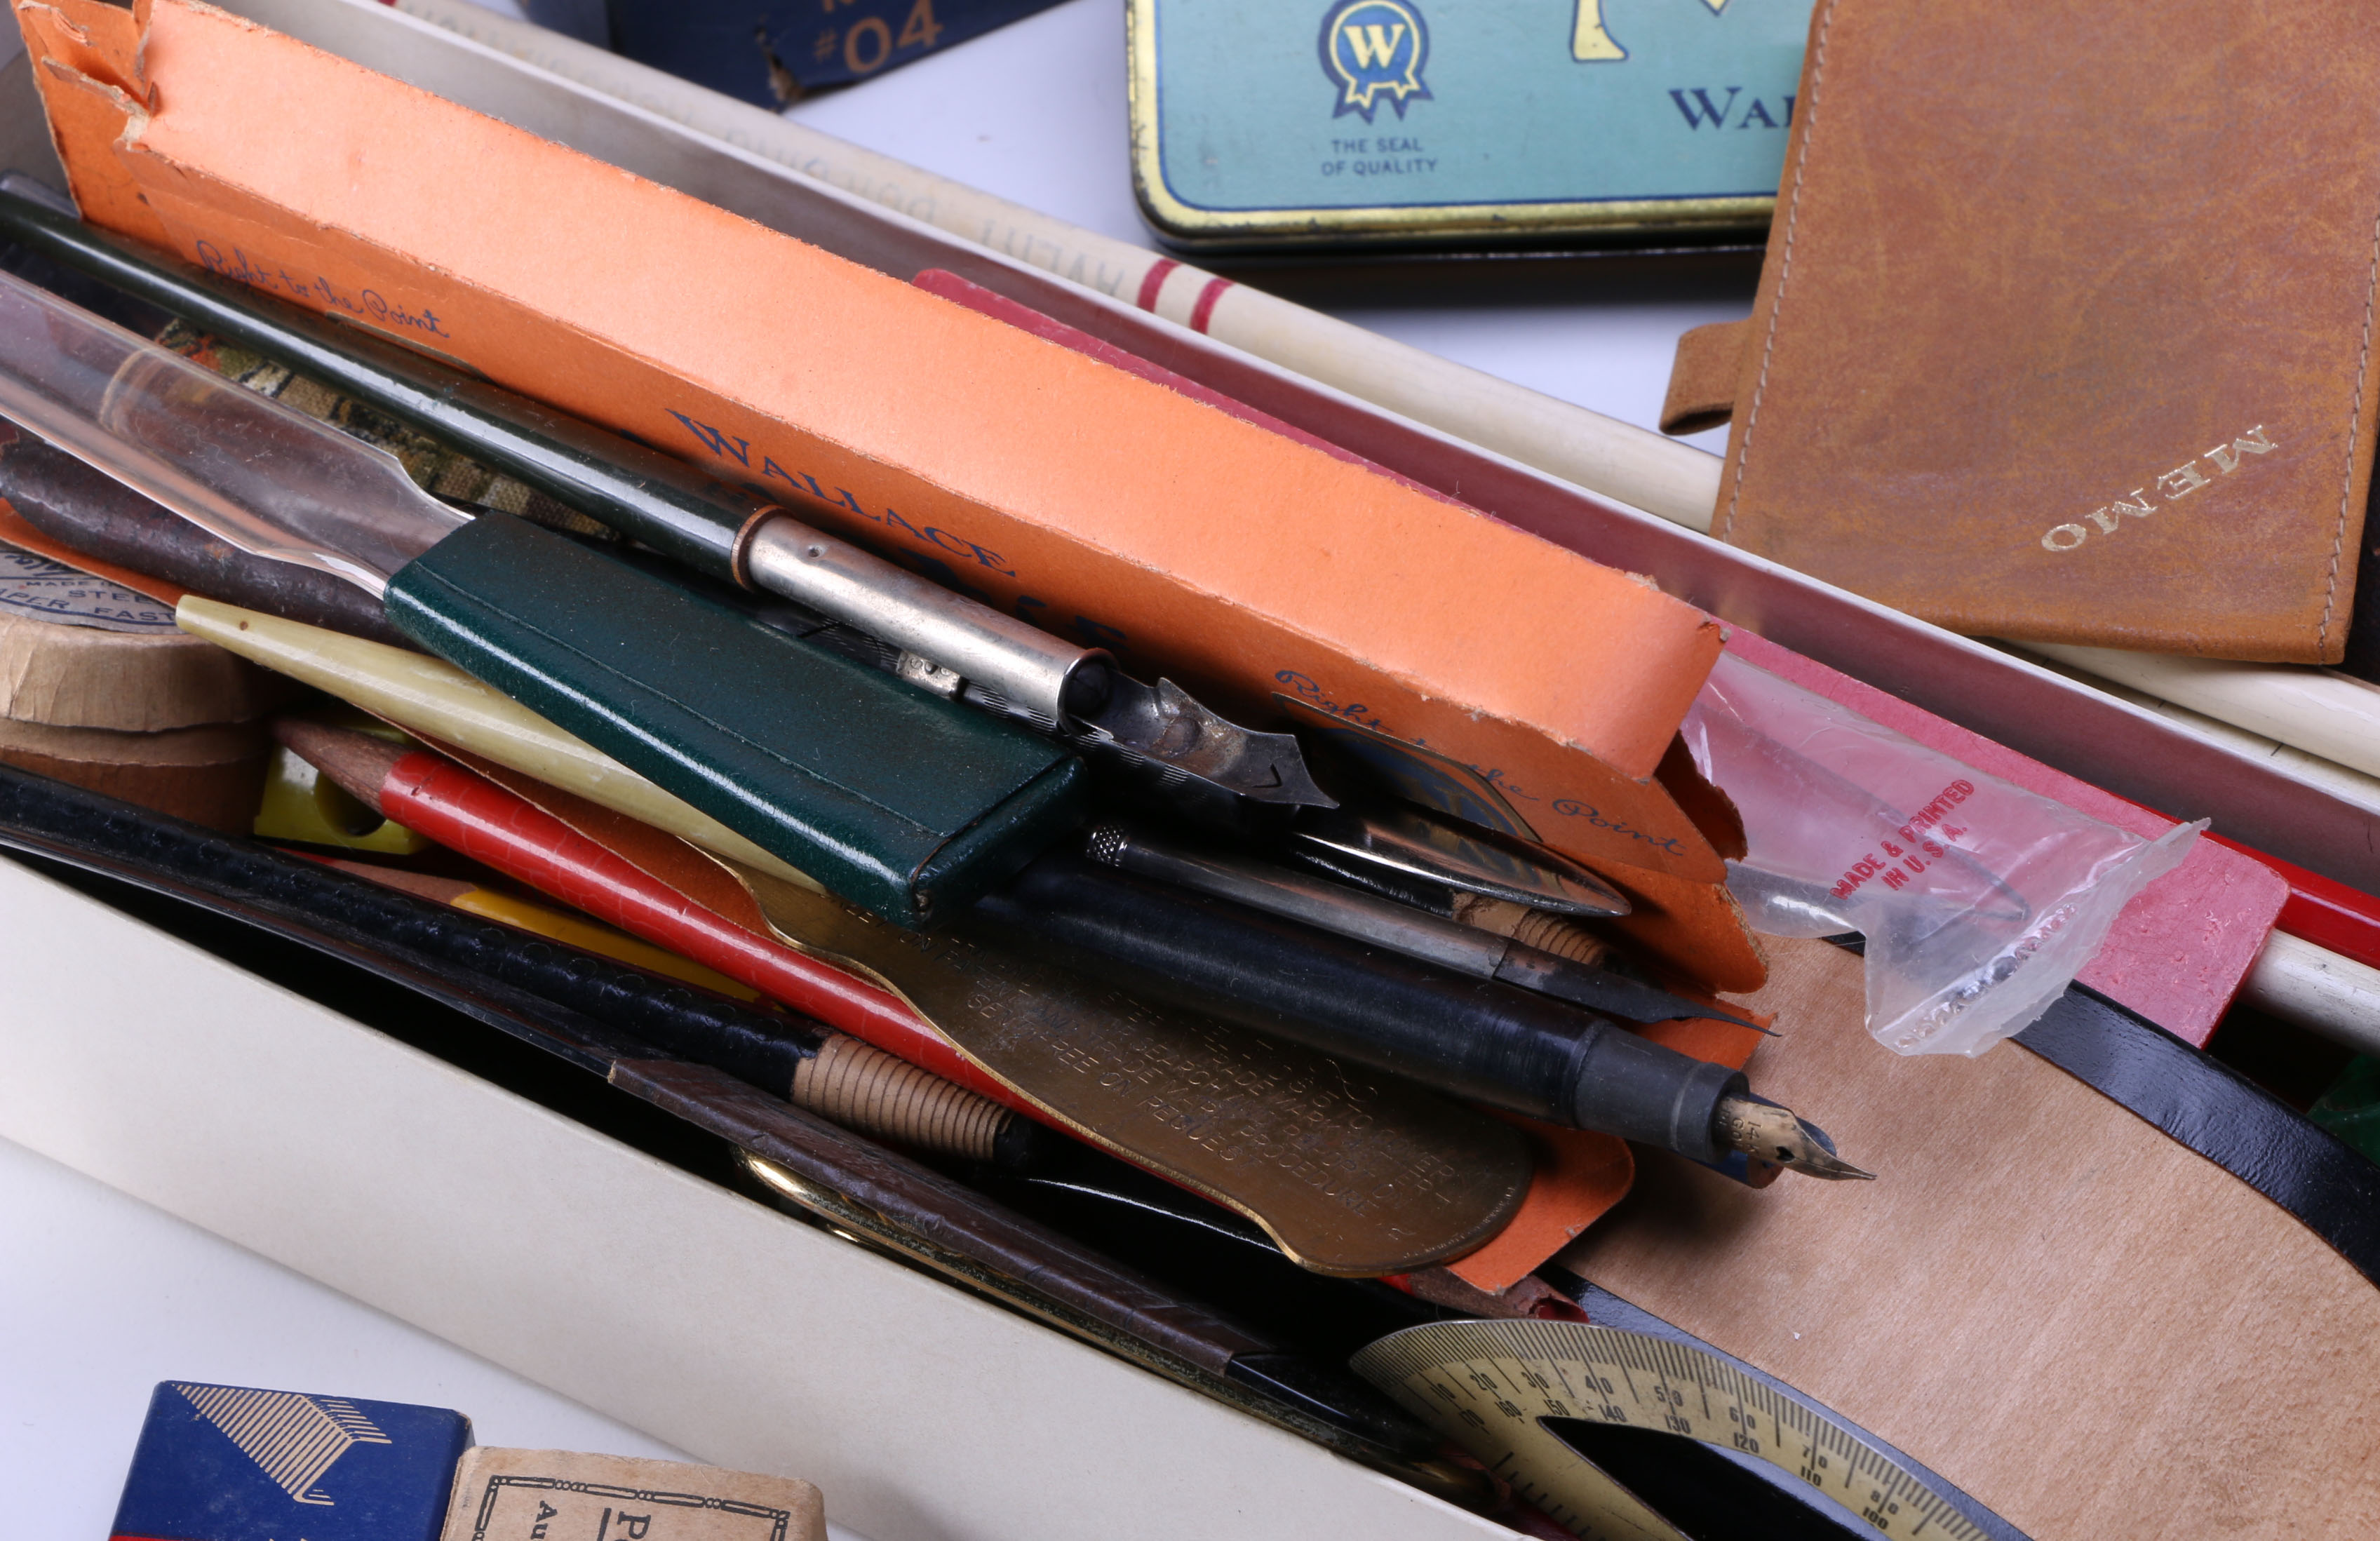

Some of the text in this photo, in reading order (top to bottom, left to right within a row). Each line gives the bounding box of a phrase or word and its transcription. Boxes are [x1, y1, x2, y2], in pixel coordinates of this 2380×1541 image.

[1343, 24, 1405, 69] W
[1321, 158, 1437, 175] OF QUALITY
[1331, 137, 1423, 154] THE SEAL
[280, 269, 310, 297] to
[314, 276, 365, 314] the
[362, 289, 450, 338] Point
[665, 408, 1016, 577] WALLACE
[2041, 424, 2278, 552] MEMO
[1552, 800, 1687, 857] Point
[1829, 779, 1975, 900] MADE & PRINTED
[1881, 868, 1909, 891] IN
[1098, 1069, 1140, 1099] ON
[1136, 1093, 1263, 1169] REQUEST
[1231, 1124, 1380, 1217] PROCEDURE
[1470, 1373, 1498, 1390] 20
[1521, 1371, 1549, 1389] 30
[1585, 1375, 1613, 1394] 40
[1654, 1385, 1683, 1406] 50
[1729, 1406, 1756, 1429] 60
[1802, 1446, 1828, 1469] 70
[1870, 1490, 1899, 1515] 80
[1495, 1400, 1522, 1418] 160
[1544, 1399, 1571, 1416] 150
[1598, 1404, 1627, 1422] 140
[1665, 1414, 1691, 1434] 130
[1733, 1432, 1759, 1454] 120
[1801, 1465, 1822, 1487] 110
[1862, 1507, 1888, 1530] 100
